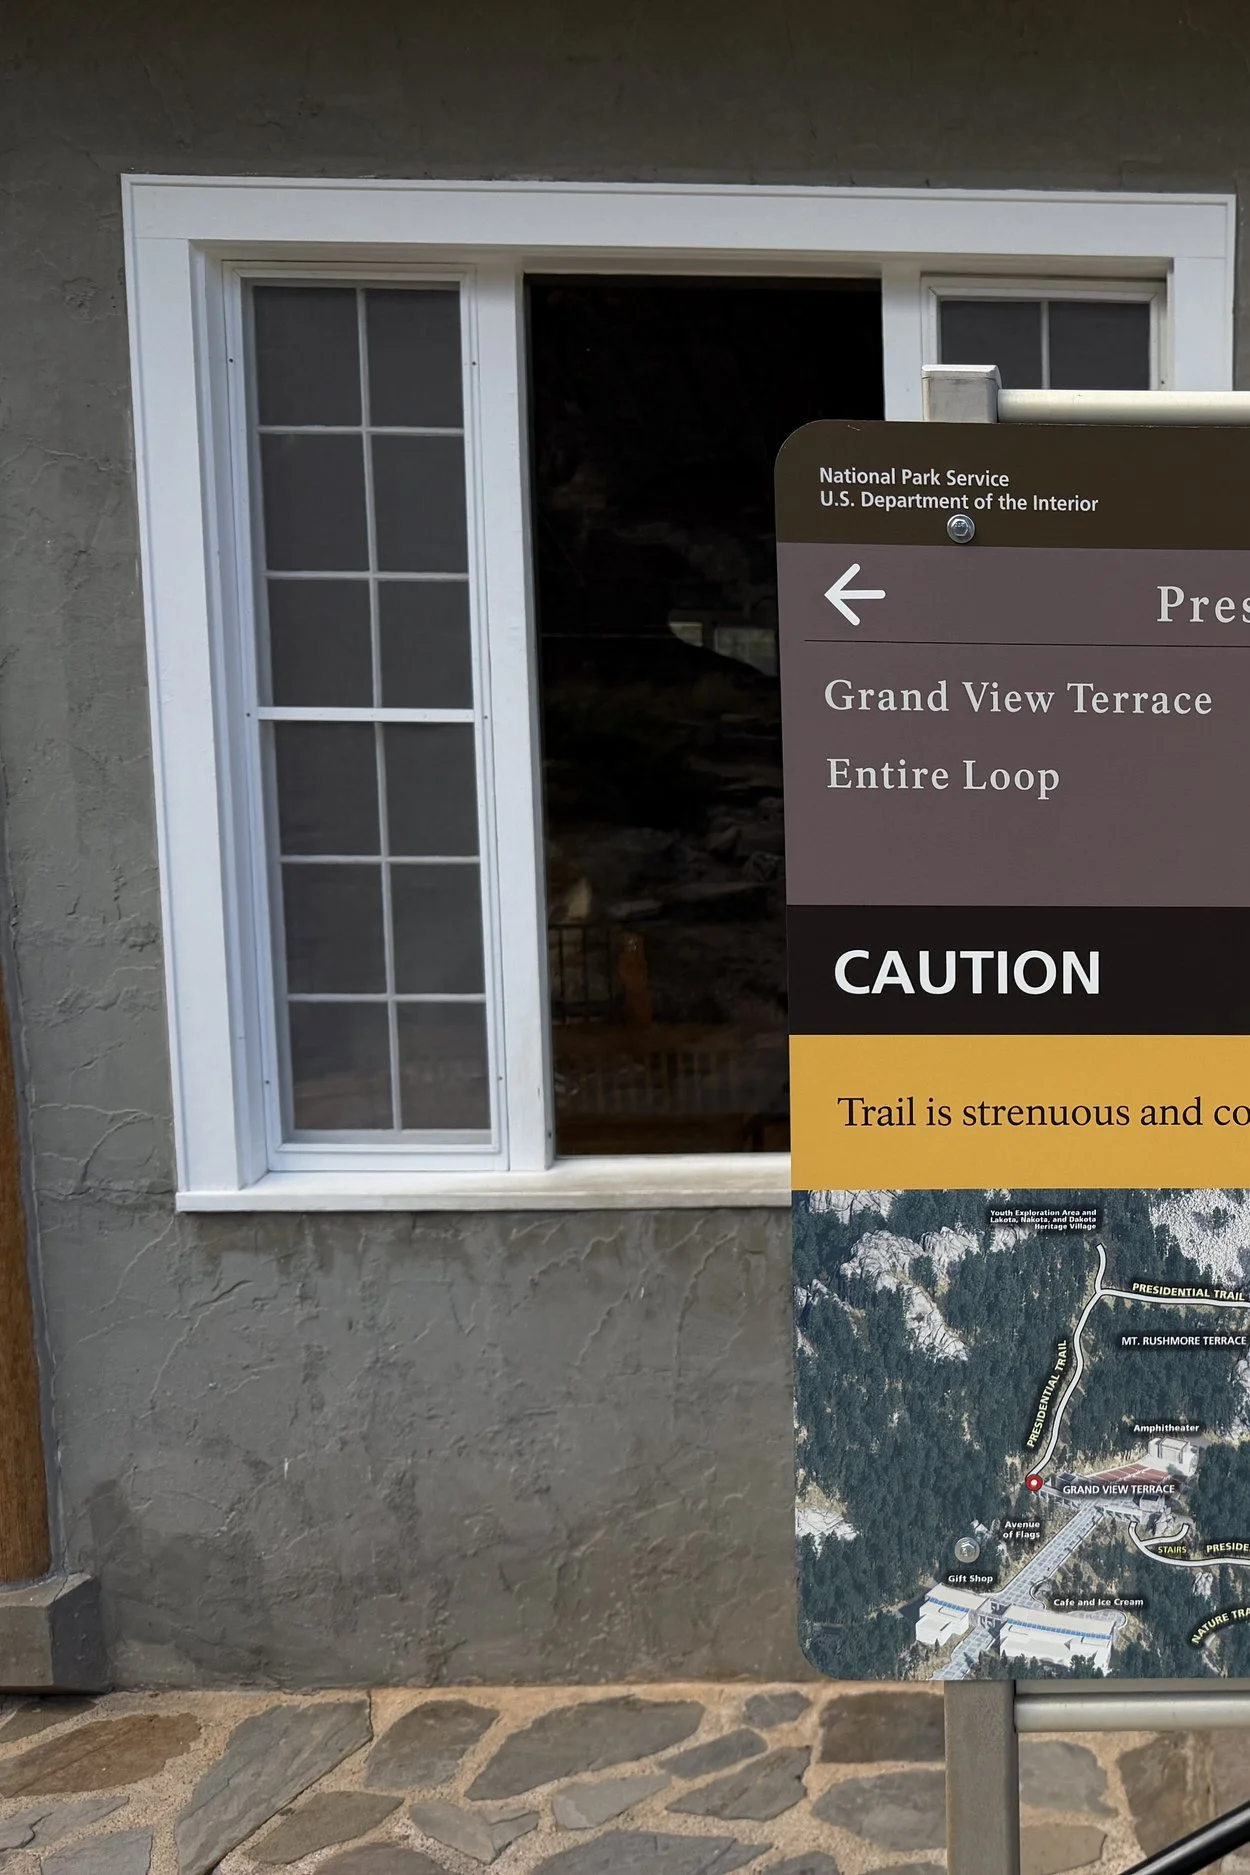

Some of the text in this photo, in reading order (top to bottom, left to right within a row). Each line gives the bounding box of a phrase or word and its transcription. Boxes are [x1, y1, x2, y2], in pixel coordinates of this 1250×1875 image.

[820, 467, 1009, 487] National Park Service
[820, 491, 1098, 512] U.S. Department of the Interior
[824, 679, 949, 712] Grand
[962, 681, 1055, 713] View
[1067, 682, 1212, 715] Terrace
[826, 758, 949, 790] Entire
[963, 760, 1060, 800] Loop
[834, 949, 1099, 995] CAUTION
[837, 1096, 916, 1127] Trail
[926, 1097, 952, 1126] is
[962, 1100, 1130, 1127] strenuous
[1141, 1095, 1203, 1127] and
[1015, 1209, 1060, 1217] Exploration
[1034, 1223, 1096, 1231] Heritage Village
[1132, 1282, 1245, 1301] PRESIDENTIAL TRAIL
[1121, 1336, 1247, 1346] MT. RUSHMORE TERRACE
[1026, 1339, 1067, 1448] PRESIDENTIAL TRAIL
[1133, 1423, 1200, 1433] Amphitheater
[1063, 1484, 1175, 1494] GRAND VIEW TERRACE
[1004, 1520, 1040, 1528] Avenue
[1003, 1530, 1040, 1540] of Flags
[1157, 1546, 1187, 1554] STAIRS
[948, 1575, 993, 1584] Gift Shop
[1191, 1612, 1229, 1645] NATURE
